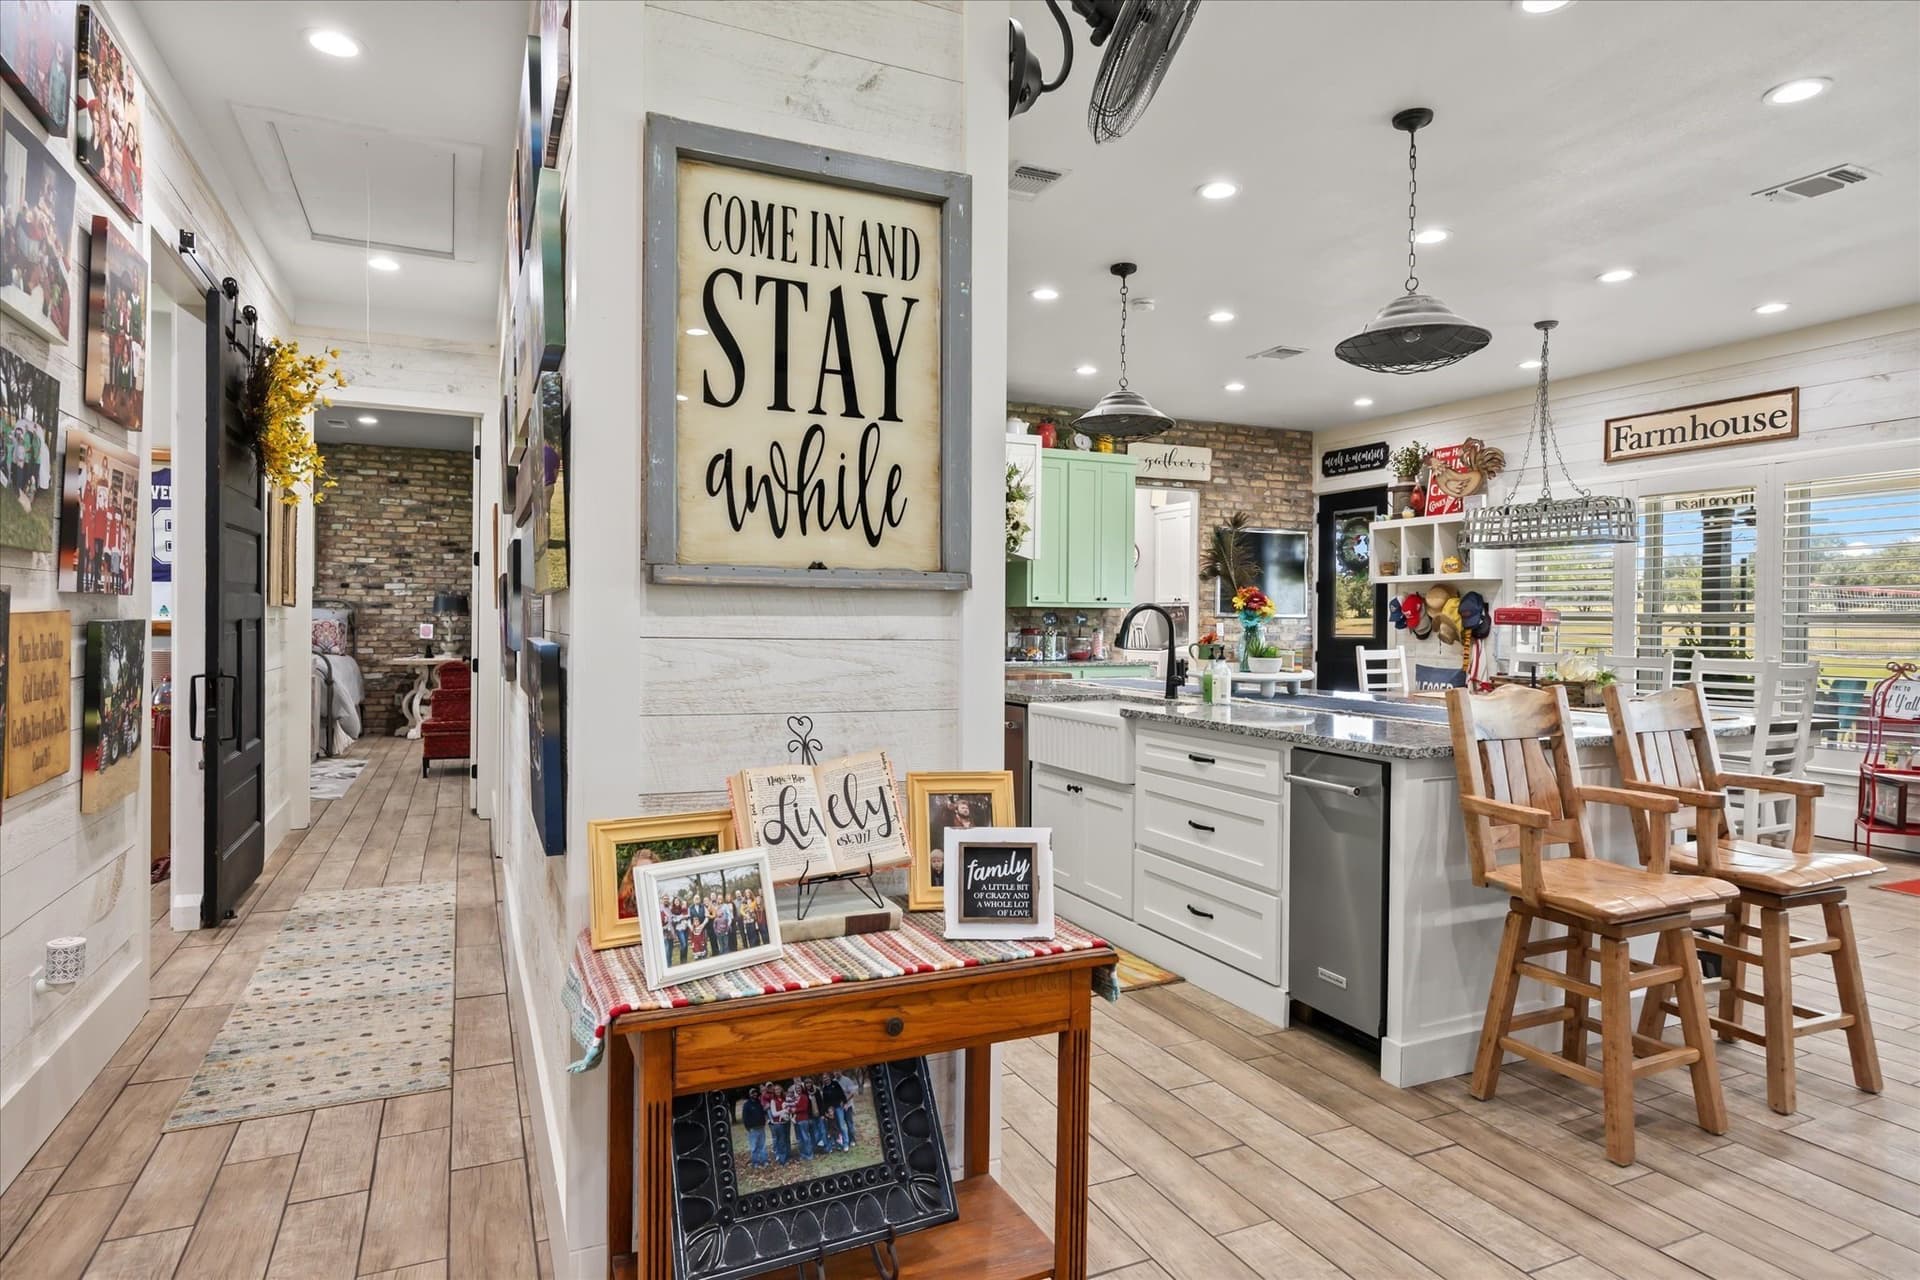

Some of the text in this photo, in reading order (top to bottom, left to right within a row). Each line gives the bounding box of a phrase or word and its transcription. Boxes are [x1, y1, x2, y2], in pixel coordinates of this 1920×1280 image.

[702, 192, 921, 282] COME IN AND
[702, 267, 920, 423] STAY
[1612, 409, 1788, 452] Farmhouse
[705, 421, 908, 548] awhile
[762, 773, 895, 850] Lively
[967, 850, 1030, 890] family
